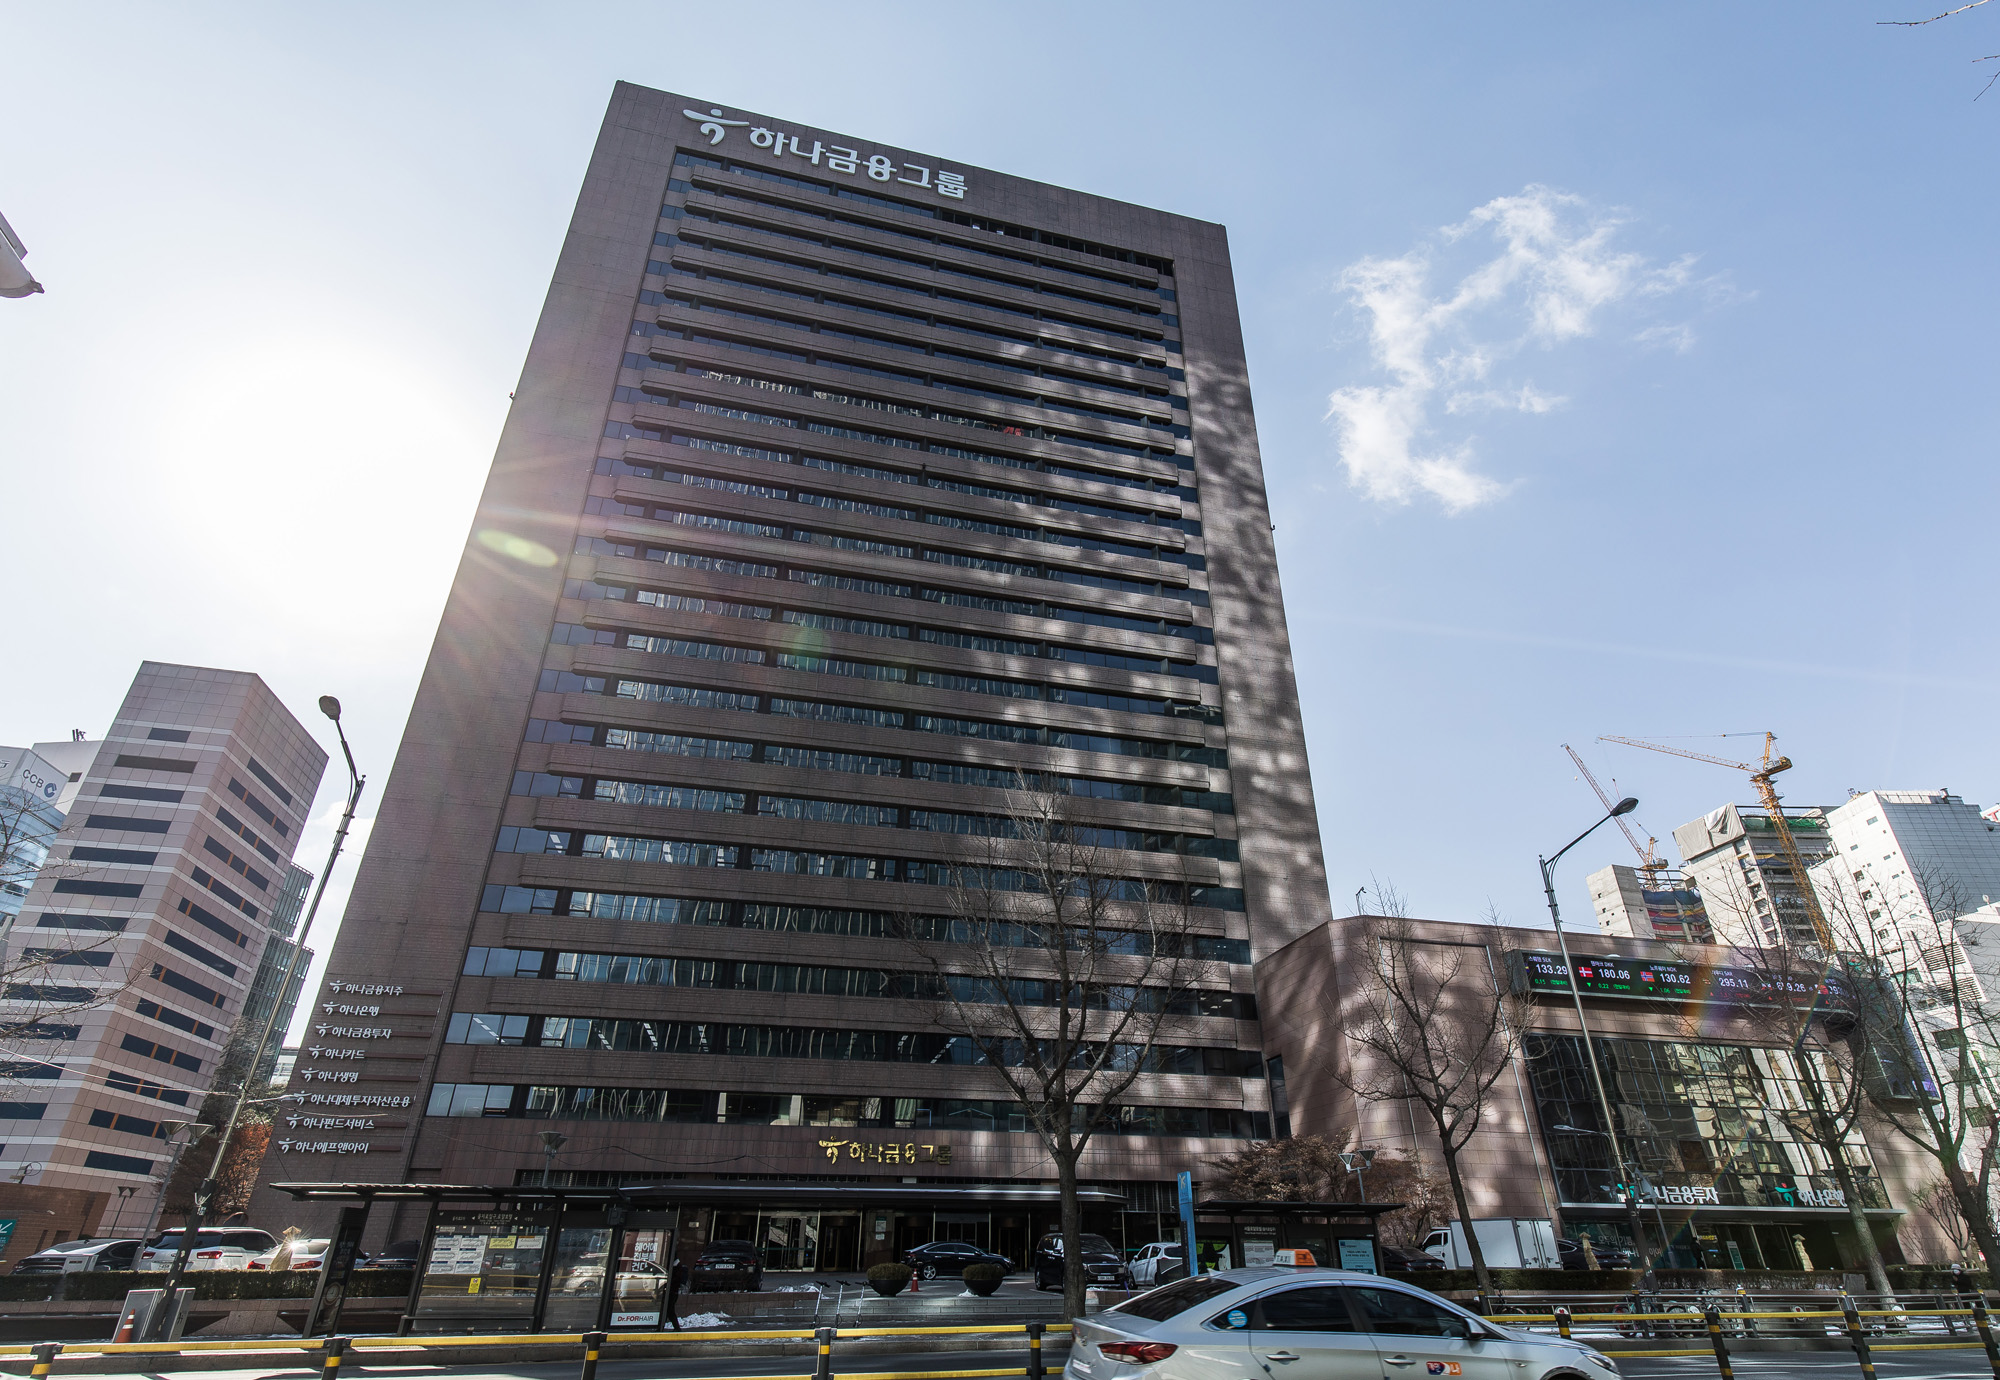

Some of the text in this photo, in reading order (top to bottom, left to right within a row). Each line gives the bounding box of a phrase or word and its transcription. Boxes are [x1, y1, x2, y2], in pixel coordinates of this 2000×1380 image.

[749, 126, 969, 200] 하나금융그룹
[22, 769, 45, 789] CCB
[1535, 963, 1568, 975] 133.29
[1598, 968, 1631, 980] 180.06
[1659, 973, 1692, 984] 130.62
[1718, 977, 1749, 989] 295.11
[345, 983, 404, 996] 하나금융지주
[1776, 981, 1807, 993] 69.26
[339, 1004, 380, 1017] 하나은행
[331, 1026, 392, 1039] 하나금융투자
[325, 1047, 365, 1060] 하나카드
[317, 1070, 359, 1083] 하나생명
[310, 1092, 411, 1108] 하나대체투자자산운용
[303, 1117, 375, 1130] 하나펀드서비스
[295, 1141, 369, 1154] 하나에프앤아이
[849, 1142, 953, 1165] 하나금융그룹
[1640, 1185, 1720, 1205] 나금융투자
[1797, 1188, 1848, 1208] 하나은행
[634, 1242, 659, 1253] 헤어에
